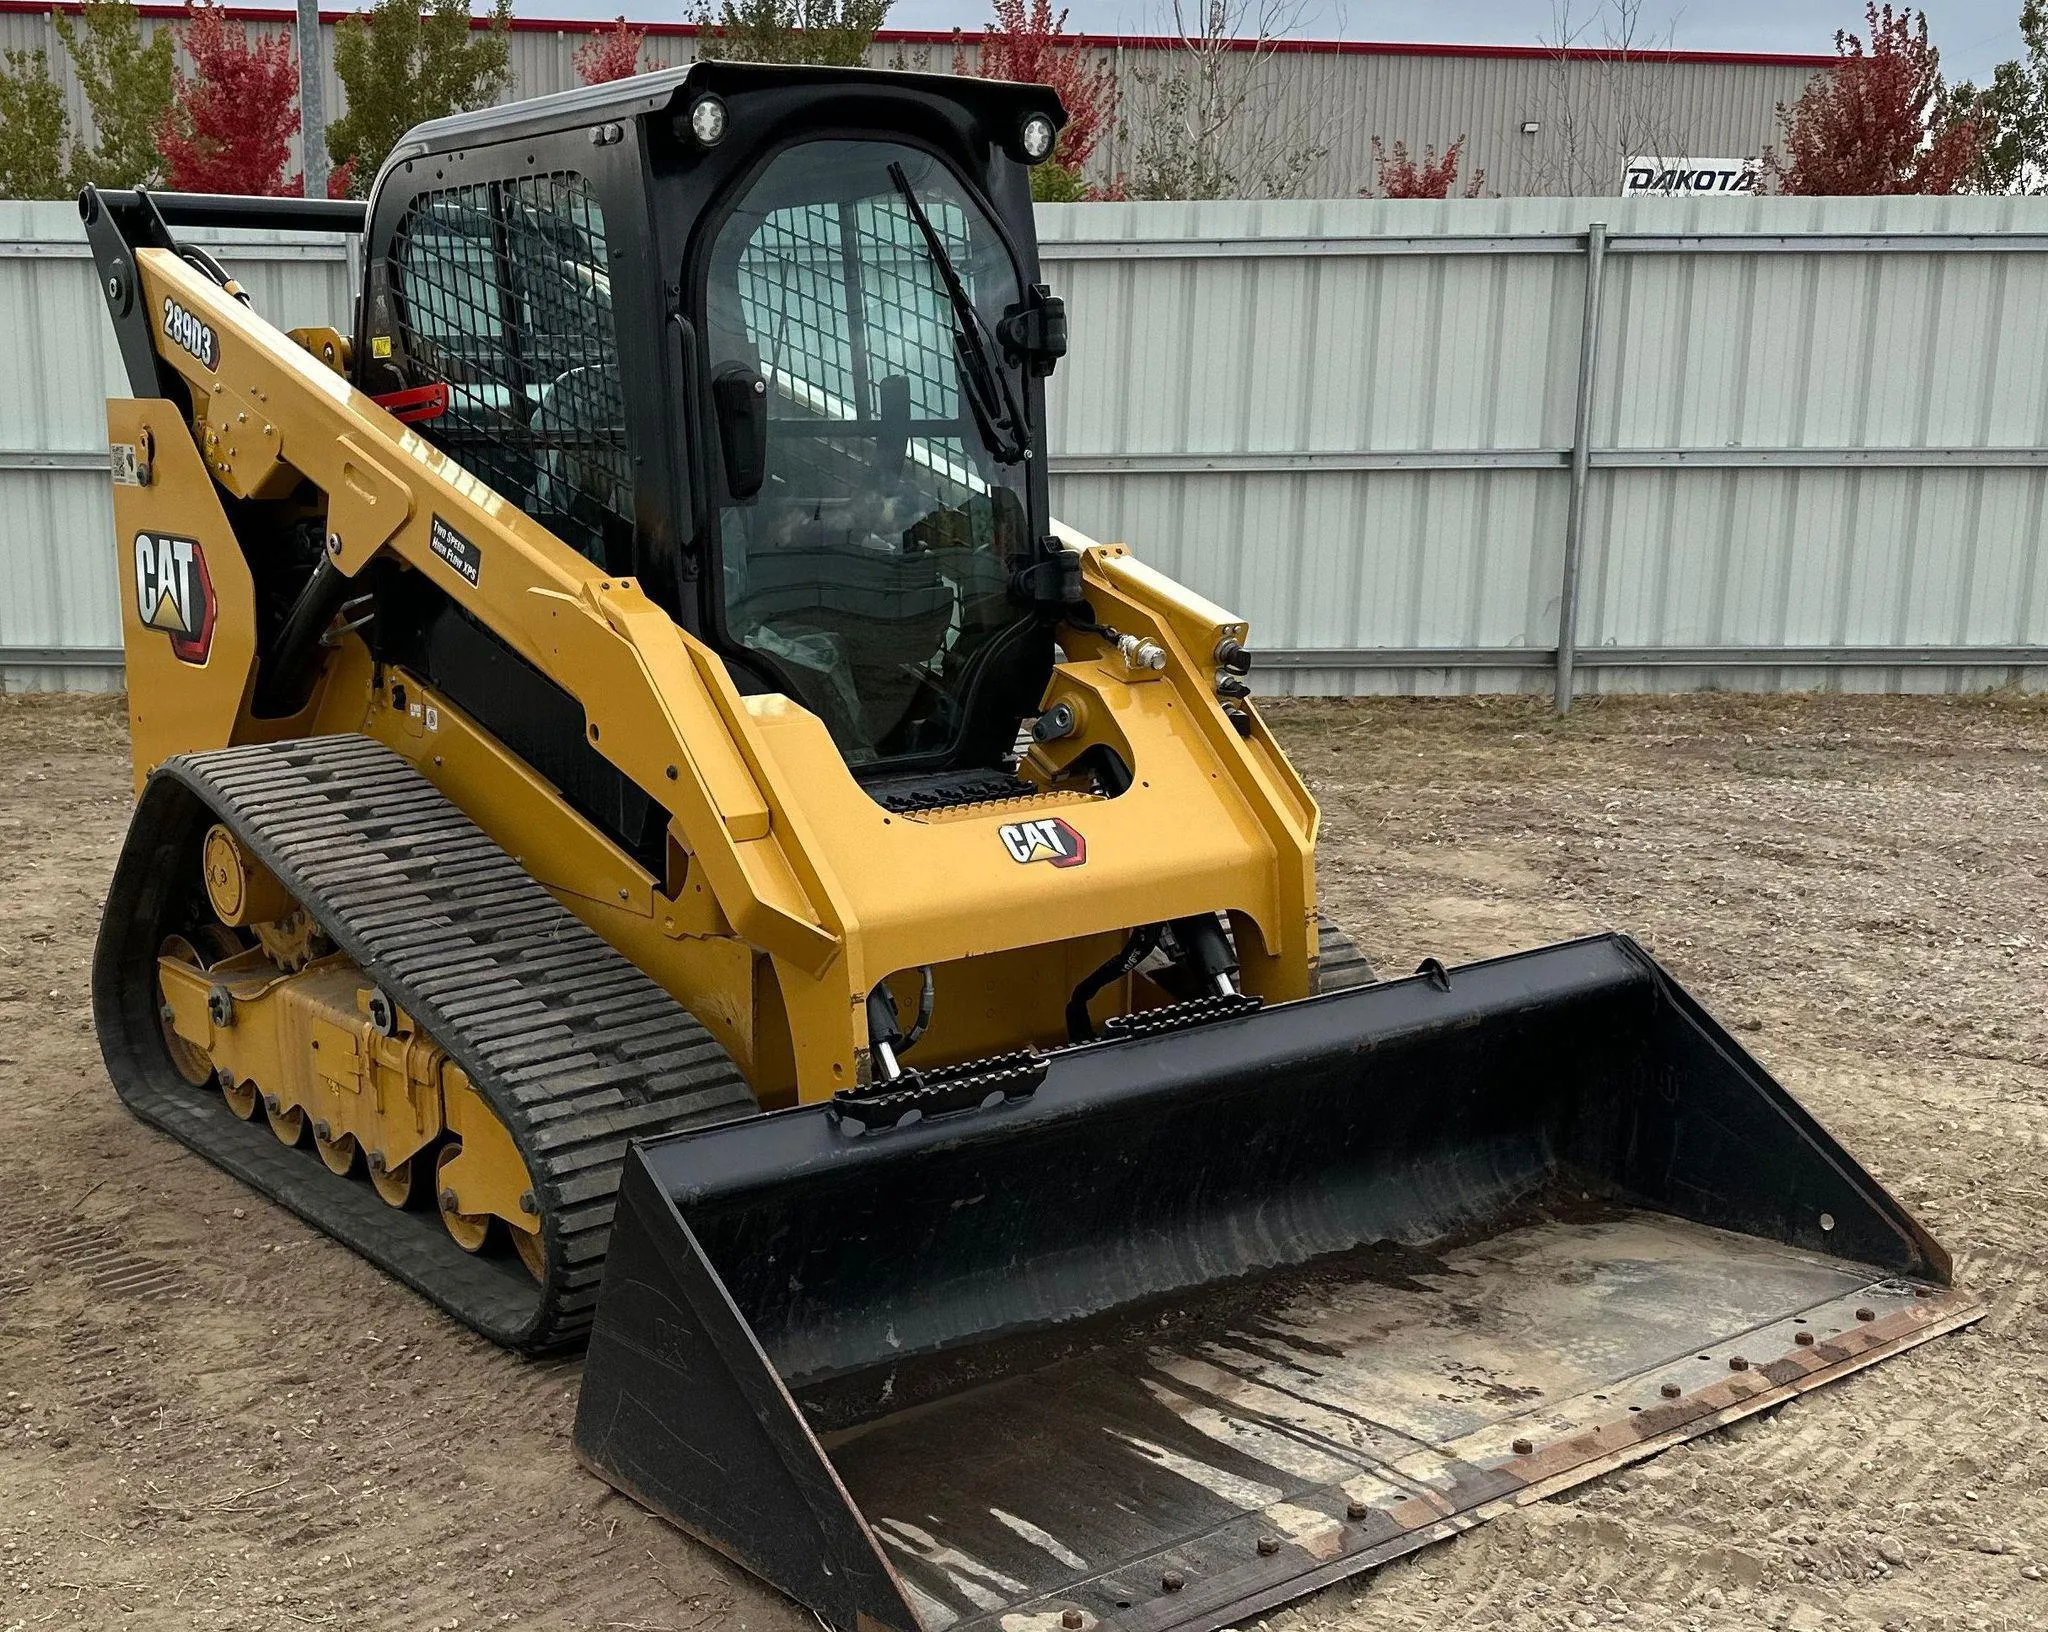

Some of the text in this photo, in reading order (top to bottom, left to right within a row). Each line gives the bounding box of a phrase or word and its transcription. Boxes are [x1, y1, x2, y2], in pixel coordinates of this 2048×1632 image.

[1628, 168, 1756, 191] DAKOTA
[164, 298, 212, 365] 289D3
[136, 534, 193, 633] CAT
[462, 561, 477, 581] XPS
[999, 819, 1068, 863] CAT
